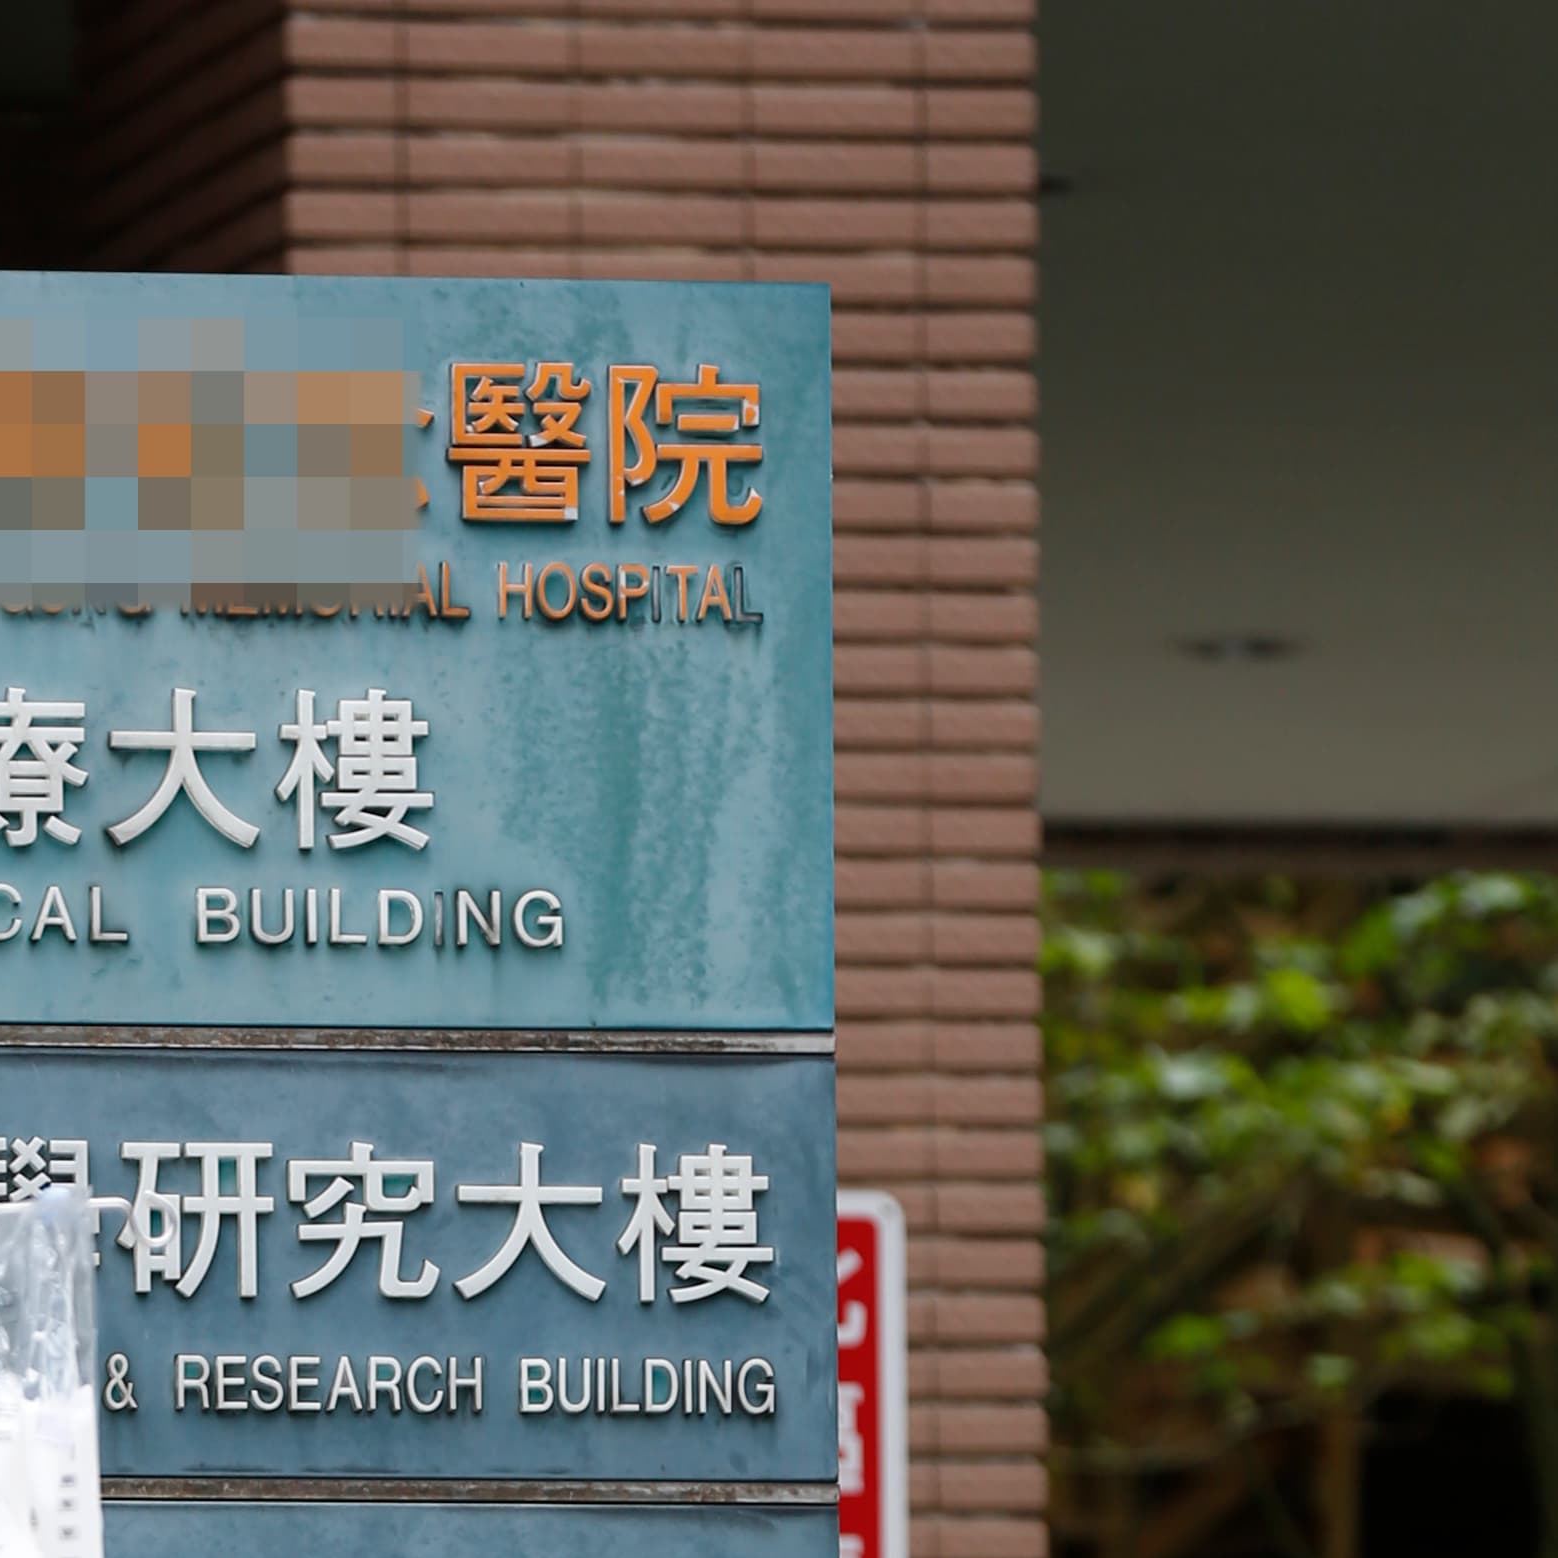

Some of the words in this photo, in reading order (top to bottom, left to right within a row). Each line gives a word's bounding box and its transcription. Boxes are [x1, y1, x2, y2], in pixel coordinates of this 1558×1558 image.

[446, 360, 764, 526] 醫院
[496, 561, 764, 624] HOSPITAL
[197, 886, 567, 951] BUILDING
[104, 1352, 139, 1411] &
[176, 1352, 485, 1414] RESEARCH
[519, 1355, 777, 1416] BUILDING
